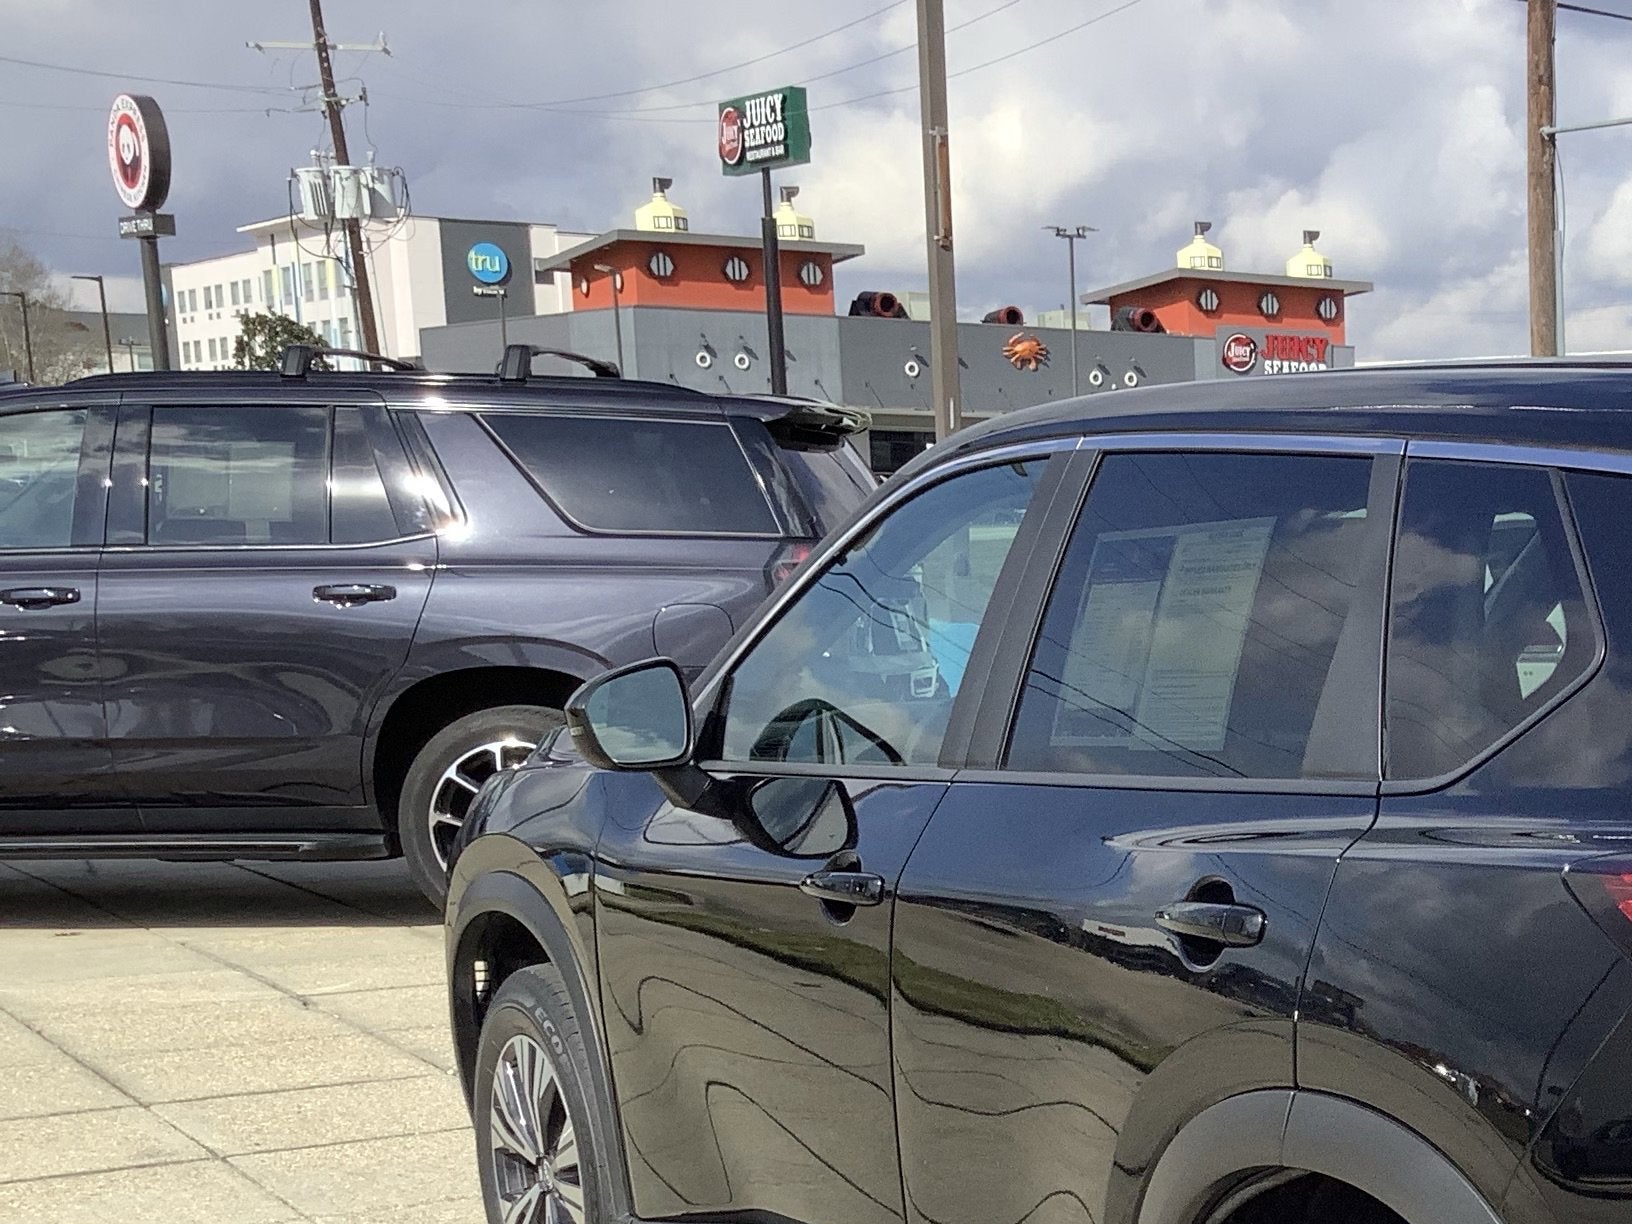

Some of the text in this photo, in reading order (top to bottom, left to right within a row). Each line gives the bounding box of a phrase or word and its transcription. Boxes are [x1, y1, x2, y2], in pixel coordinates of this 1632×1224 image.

[743, 93, 784, 128] JUICY
[744, 122, 785, 148] SEAFOOD
[120, 220, 137, 235] DRIVE
[467, 250, 500, 272] tru
[1261, 335, 1329, 363] JUICY
